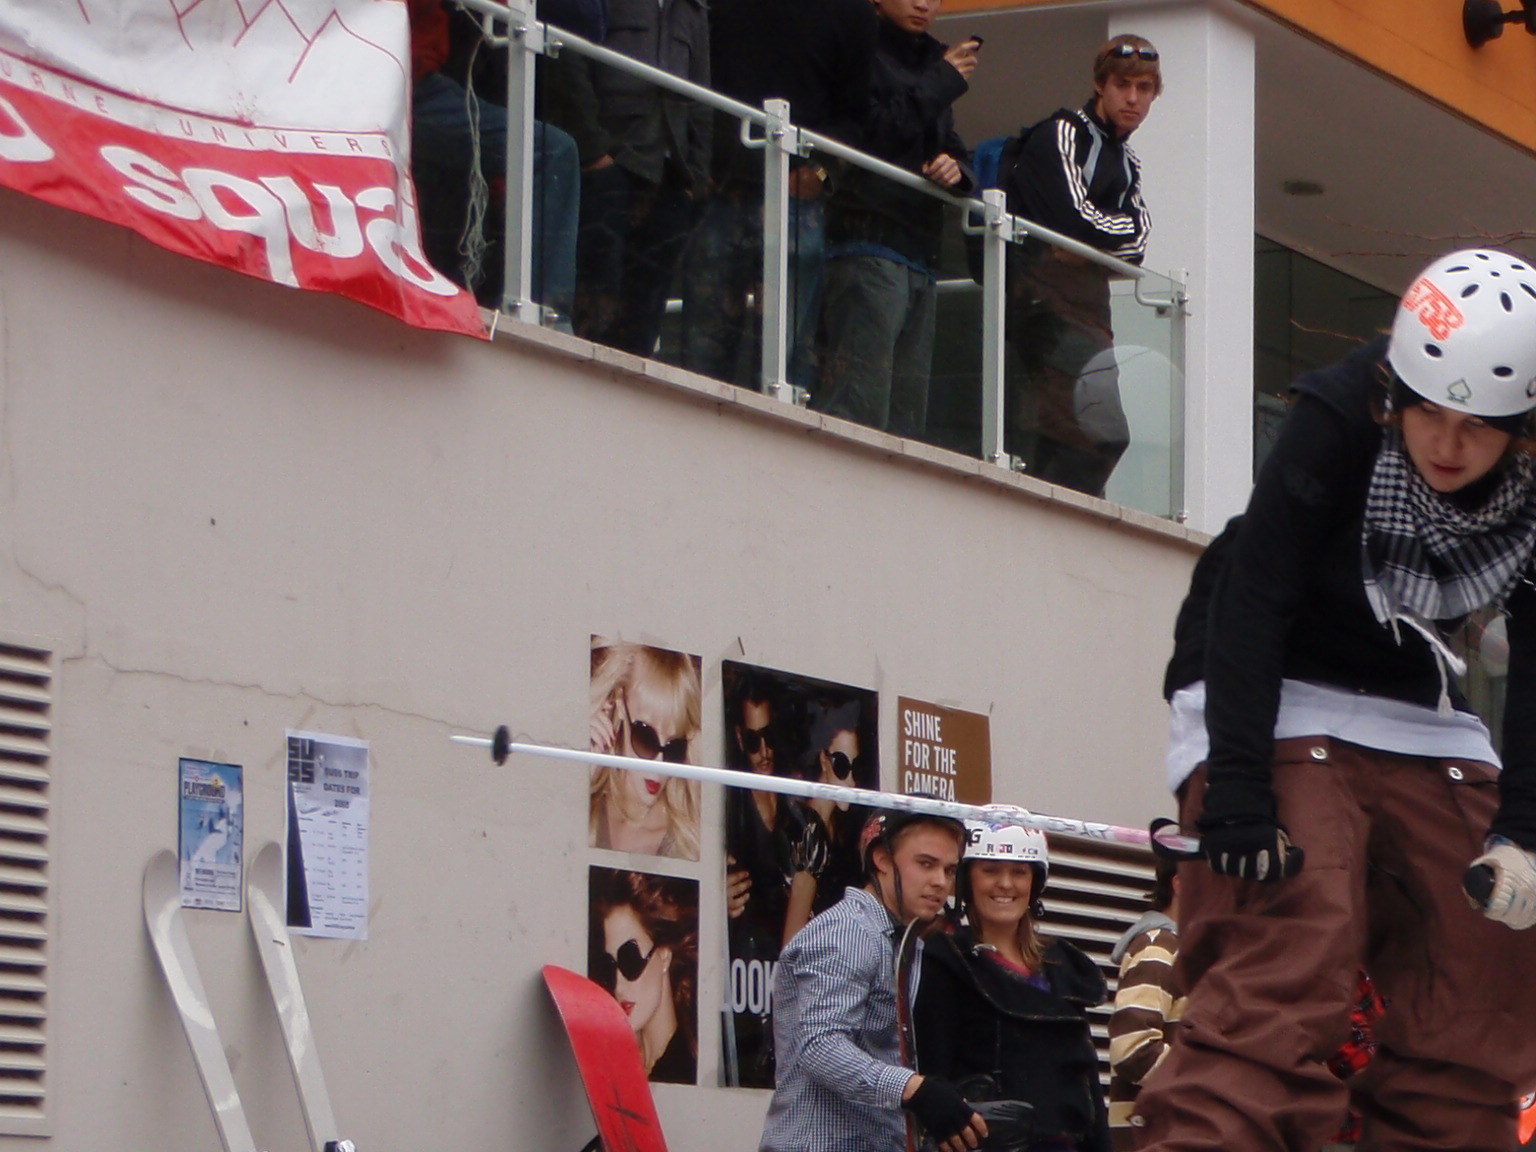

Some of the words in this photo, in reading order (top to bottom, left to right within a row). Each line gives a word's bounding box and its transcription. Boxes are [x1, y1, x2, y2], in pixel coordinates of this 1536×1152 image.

[904, 709, 943, 743] SHINE
[904, 739, 931, 771] FOR
[933, 745, 958, 776] THE
[347, 785, 361, 796] FOR
